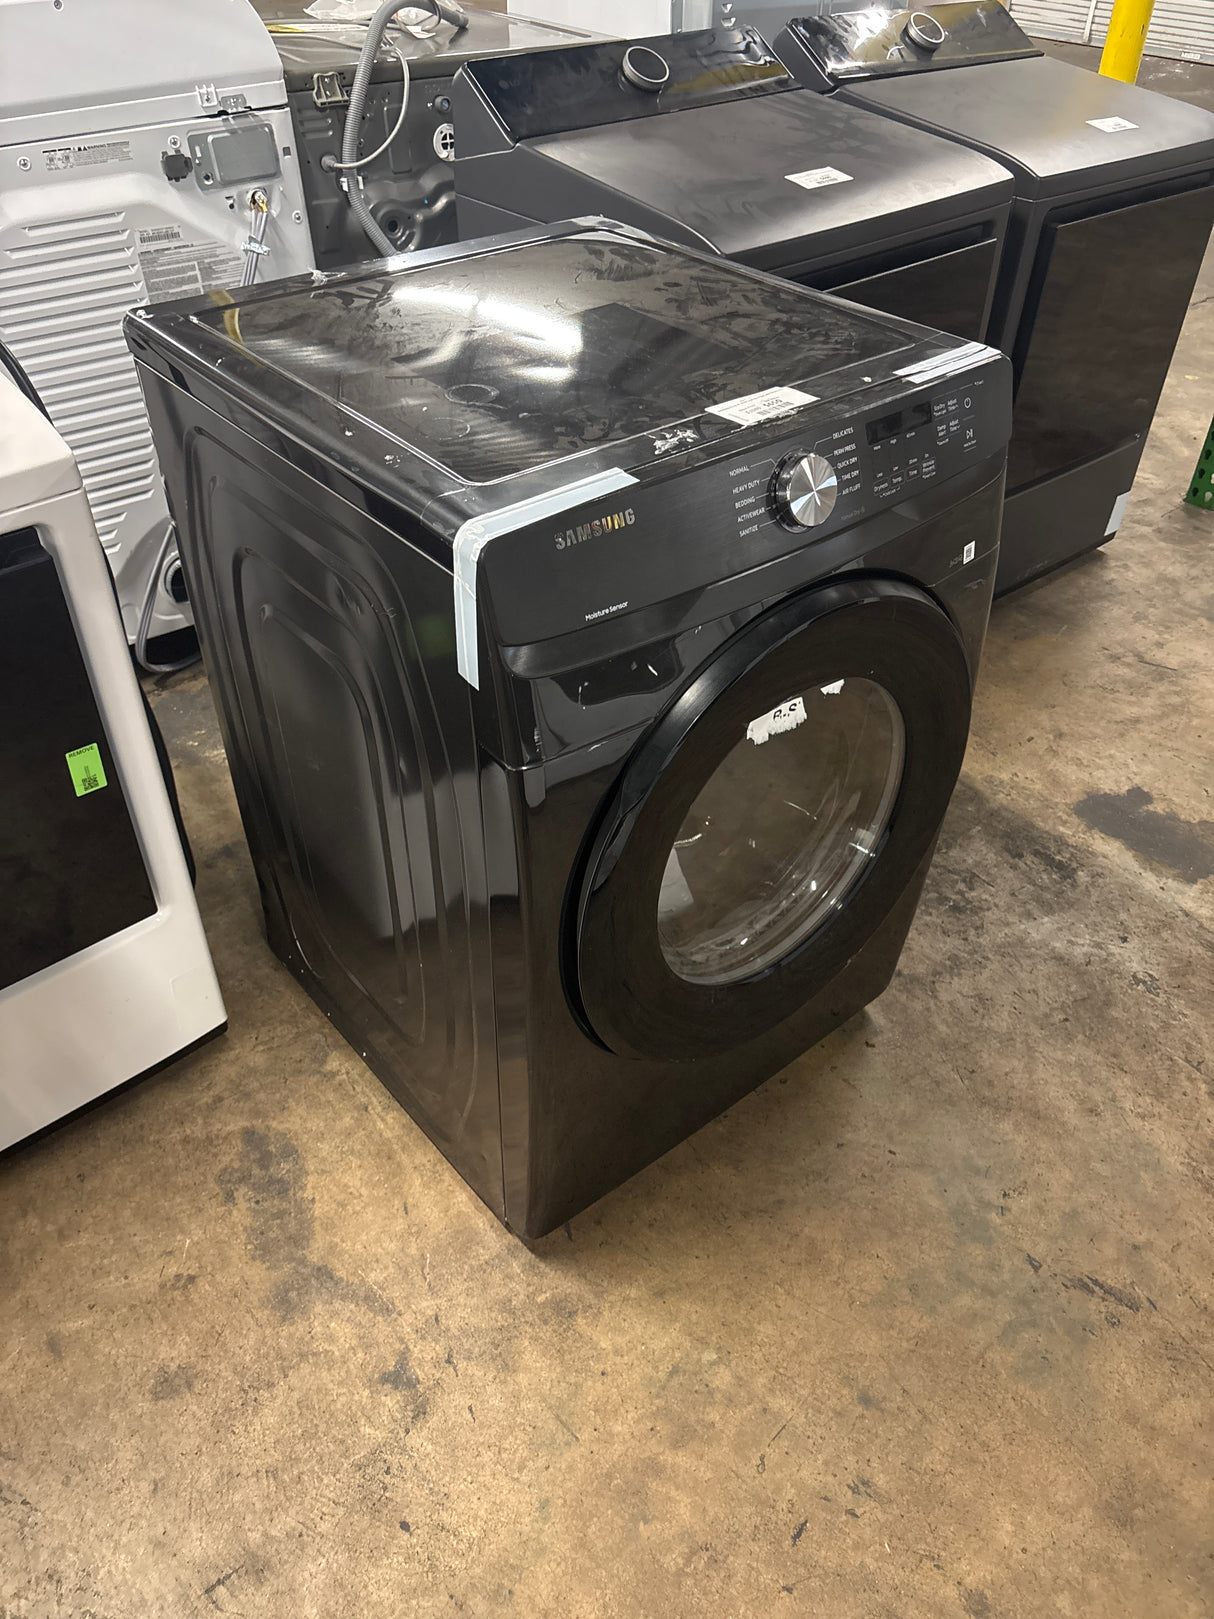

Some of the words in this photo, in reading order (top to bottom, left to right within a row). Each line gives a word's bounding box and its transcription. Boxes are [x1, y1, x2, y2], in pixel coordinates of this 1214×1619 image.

[832, 426, 854, 440] DELICATES
[833, 446, 845, 456] PERM
[844, 442, 857, 452] PRESS
[836, 459, 849, 470] QUICK
[849, 456, 858, 465] DRY
[729, 465, 750, 477] NORMAL
[841, 472, 851, 481] TIME
[850, 469, 860, 478] DRY
[732, 483, 748, 495] HEAVY
[747, 479, 760, 489] DUTY
[842, 487, 850, 496] AIR
[734, 495, 756, 509] BEDDING
[737, 507, 766, 523] ACTIVEWEAR
[554, 507, 636, 550] SAMSUNG
[739, 524, 759, 538] SANITIZE
[585, 606, 609, 621] Moisture
[609, 600, 629, 613] Sensor
[68, 745, 95, 758] REMOVE
